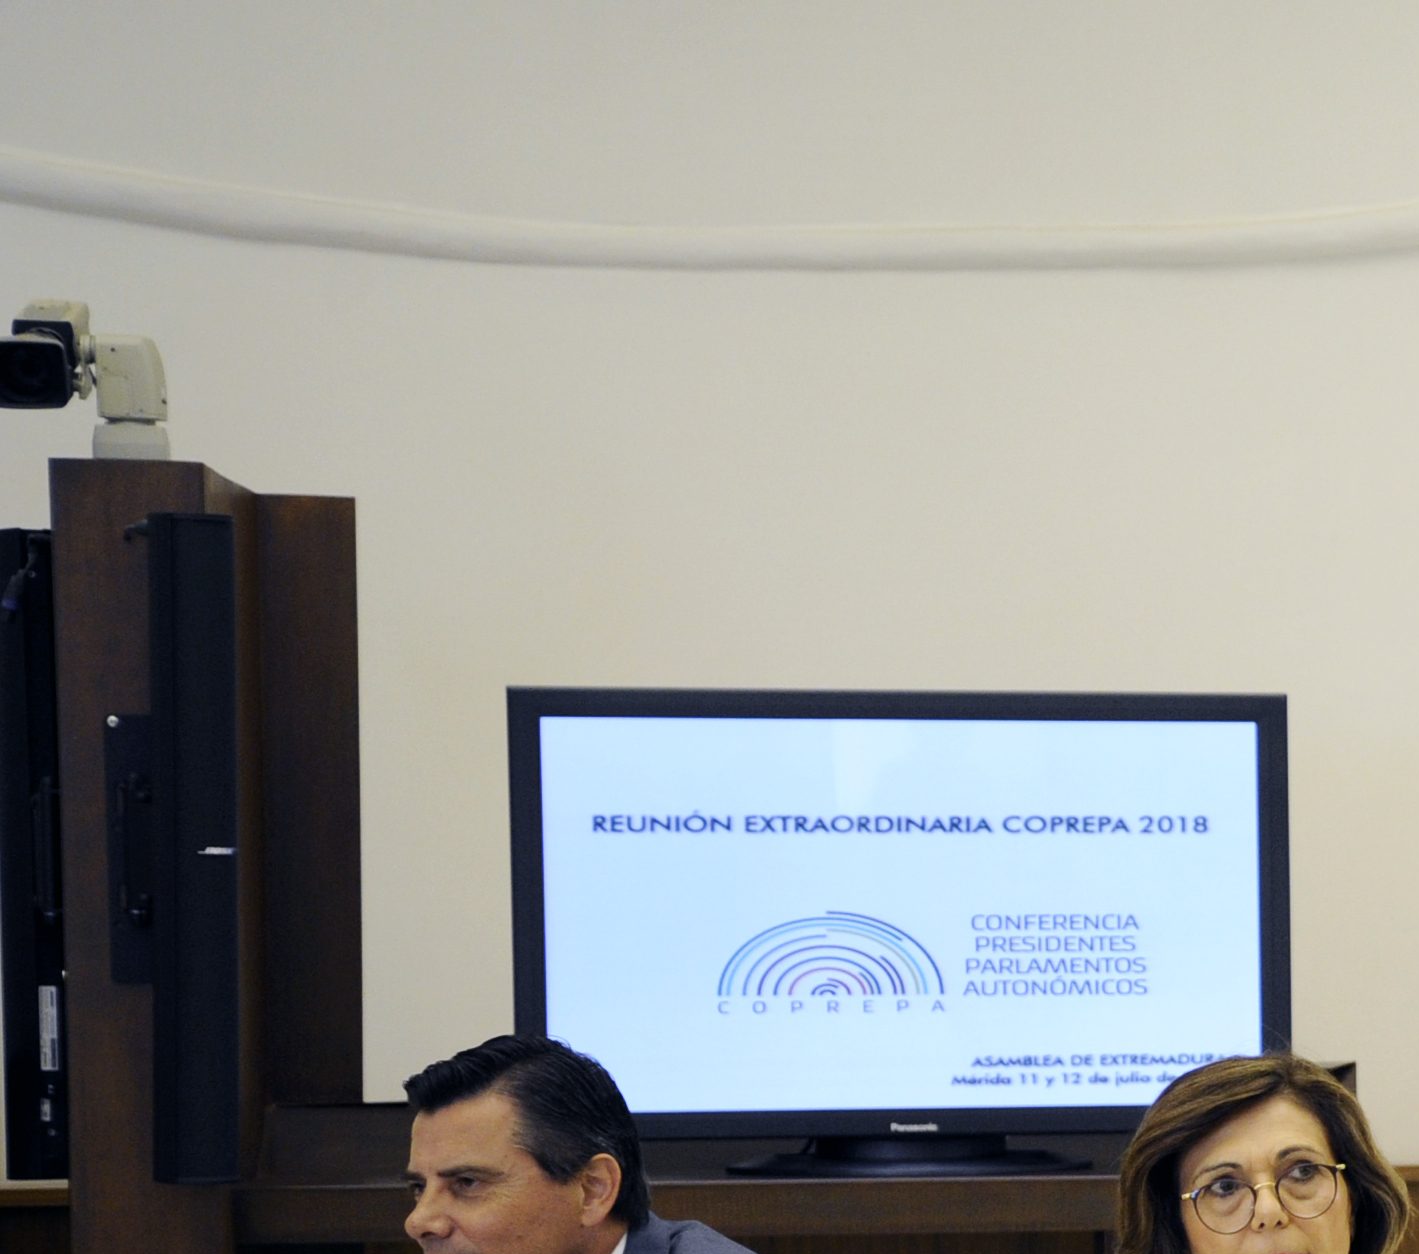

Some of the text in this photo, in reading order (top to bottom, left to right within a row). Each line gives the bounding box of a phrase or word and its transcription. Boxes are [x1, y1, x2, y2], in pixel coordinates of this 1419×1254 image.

[592, 809, 1209, 833] REUNIÓN EXTRAORDINARIA COPREPA 2018
[970, 913, 1140, 931] CONFERENCIA
[974, 935, 1137, 952] PRESIDENTES
[964, 957, 1147, 974] PARLAMENTOS
[963, 975, 1148, 996] AUTONÓMICOS
[717, 1000, 945, 1014] COPREPA
[971, 1054, 1064, 1067] ASAMBLEA
[1071, 1054, 1093, 1066] DE
[951, 1072, 1011, 1085] Mérida
[1020, 1072, 1038, 1085] 11
[1045, 1076, 1053, 1087] y
[1062, 1072, 1081, 1084] 12
[1088, 1072, 1107, 1084] de
[1114, 1071, 1150, 1086] julio
